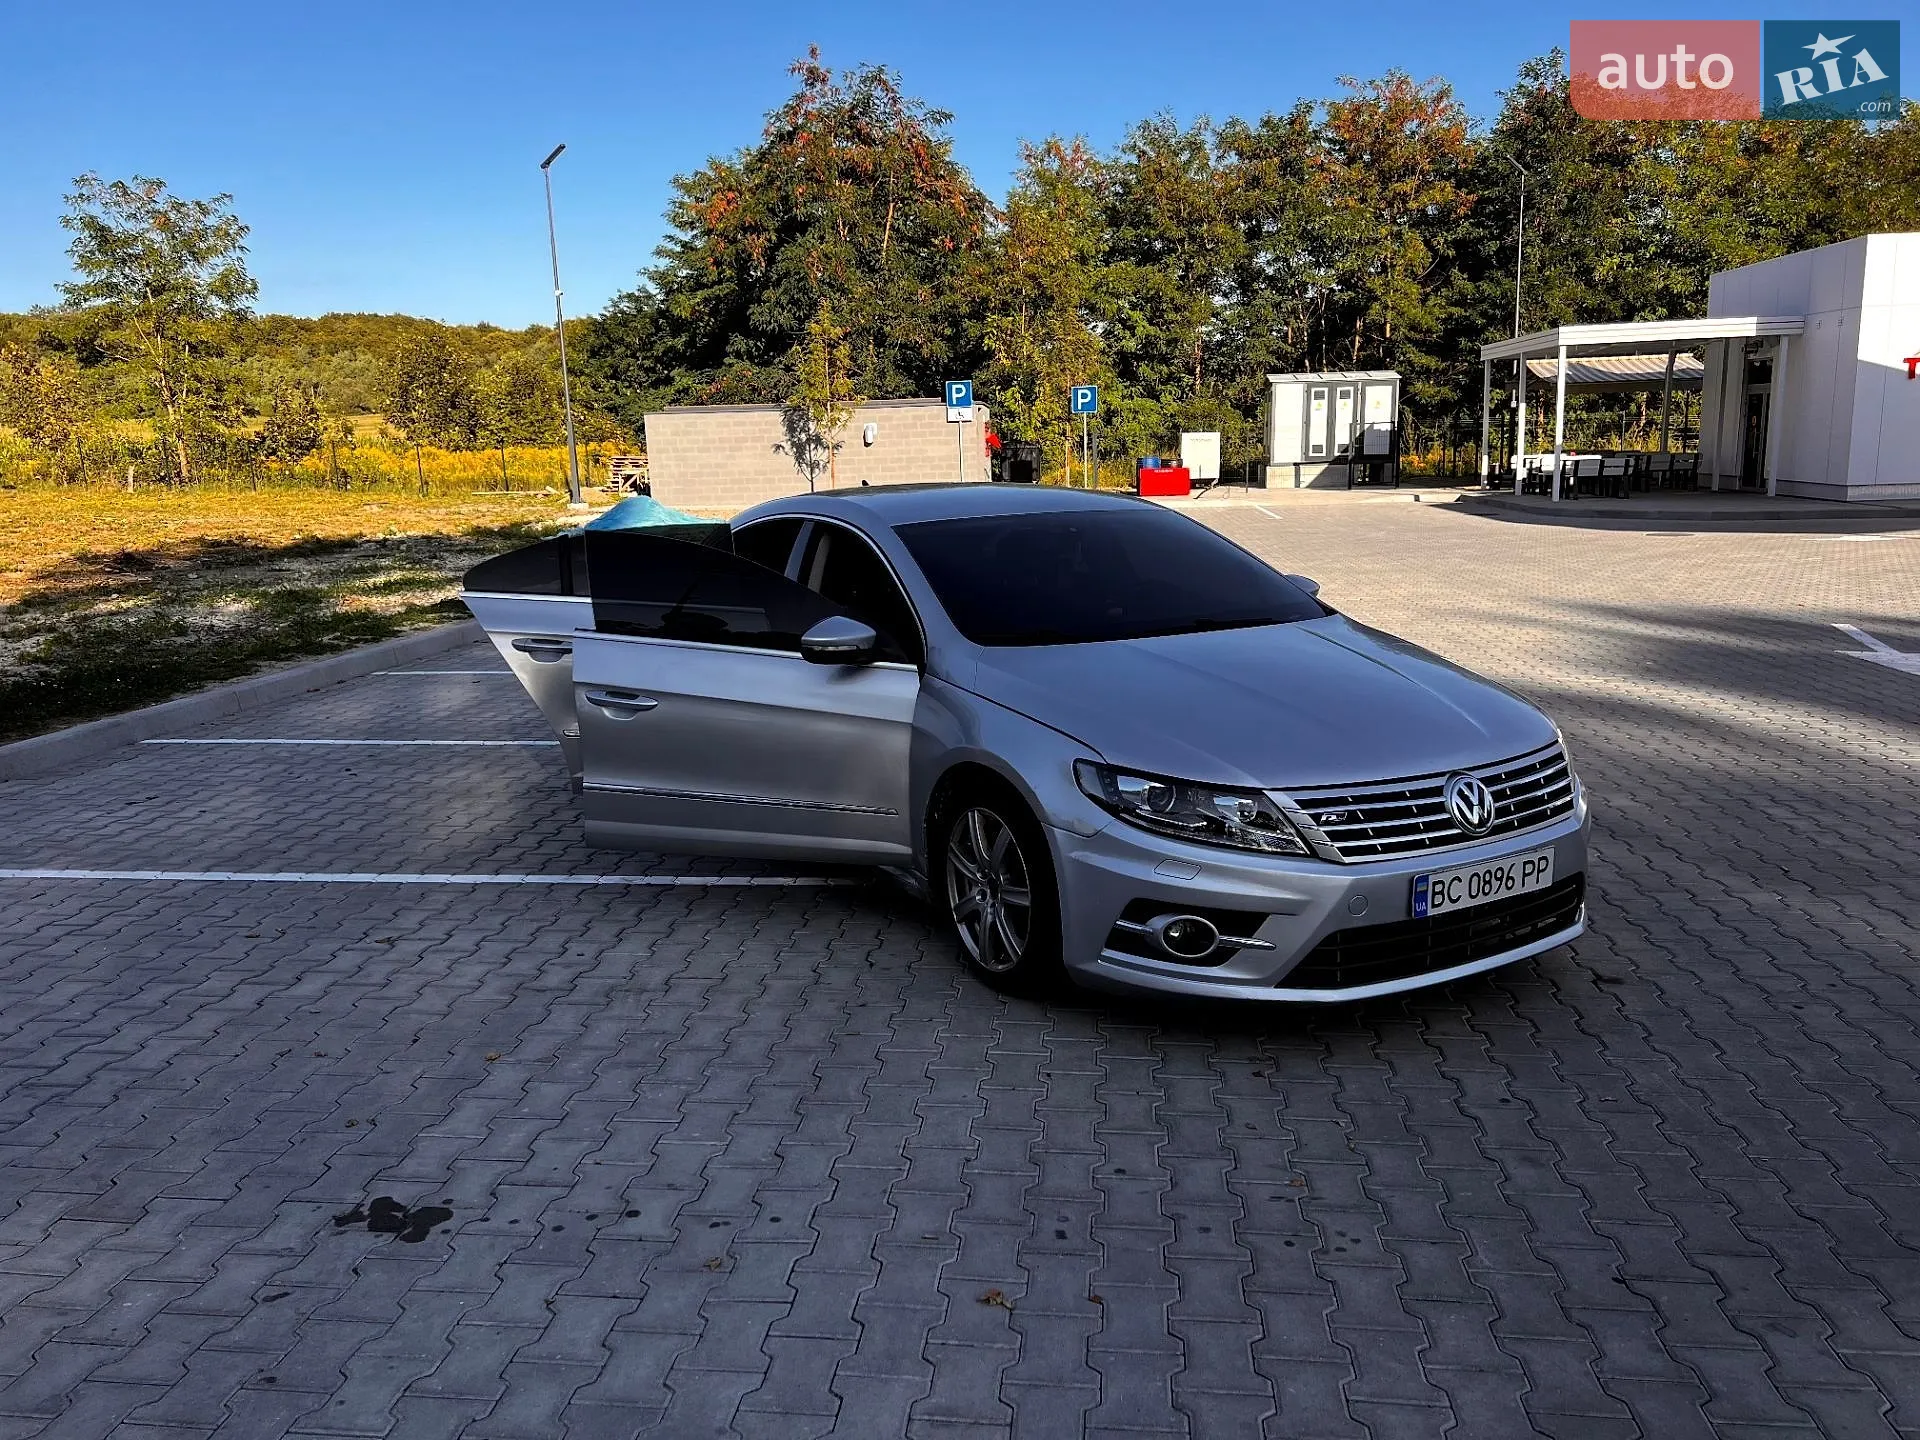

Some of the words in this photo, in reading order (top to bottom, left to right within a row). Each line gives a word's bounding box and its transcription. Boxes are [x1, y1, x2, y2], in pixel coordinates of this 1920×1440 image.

[951, 384, 966, 405] P
[1077, 389, 1092, 410] P
[1431, 876, 1463, 910] BC
[1468, 863, 1516, 900] 0896
[1521, 855, 1550, 889] PP
[1415, 901, 1428, 912] UA
